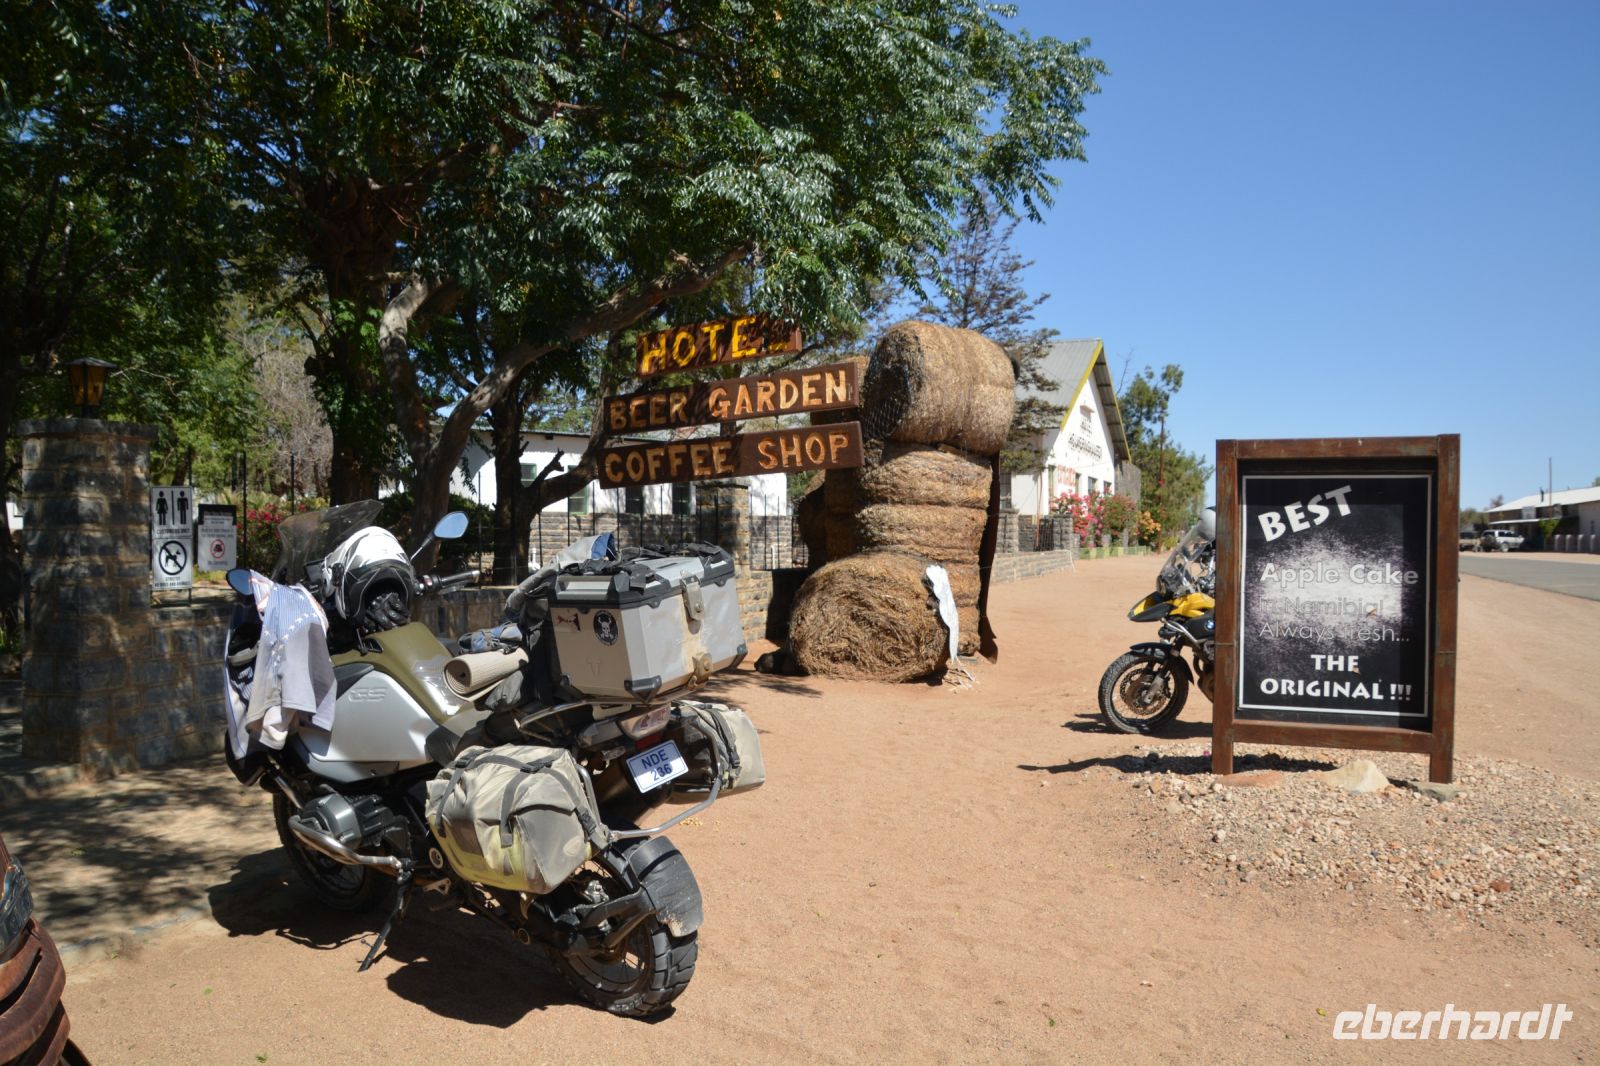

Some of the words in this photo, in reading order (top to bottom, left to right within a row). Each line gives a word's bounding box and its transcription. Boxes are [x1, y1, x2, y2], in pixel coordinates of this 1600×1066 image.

[610, 391, 689, 430] BEER
[708, 369, 848, 418] GARDEN
[604, 440, 735, 483] COFFEE
[757, 432, 849, 470] SHOP
[1257, 484, 1353, 542] BEST
[1260, 562, 1340, 589] Apple
[1349, 562, 1419, 585] Cake
[1259, 621, 1334, 642] Always
[1310, 654, 1360, 672] THE
[1260, 678, 1384, 700] ORIGINAL
[1390, 683, 1412, 700] !!!
[641, 749, 669, 770] NDE
[650, 763, 673, 781] 236
